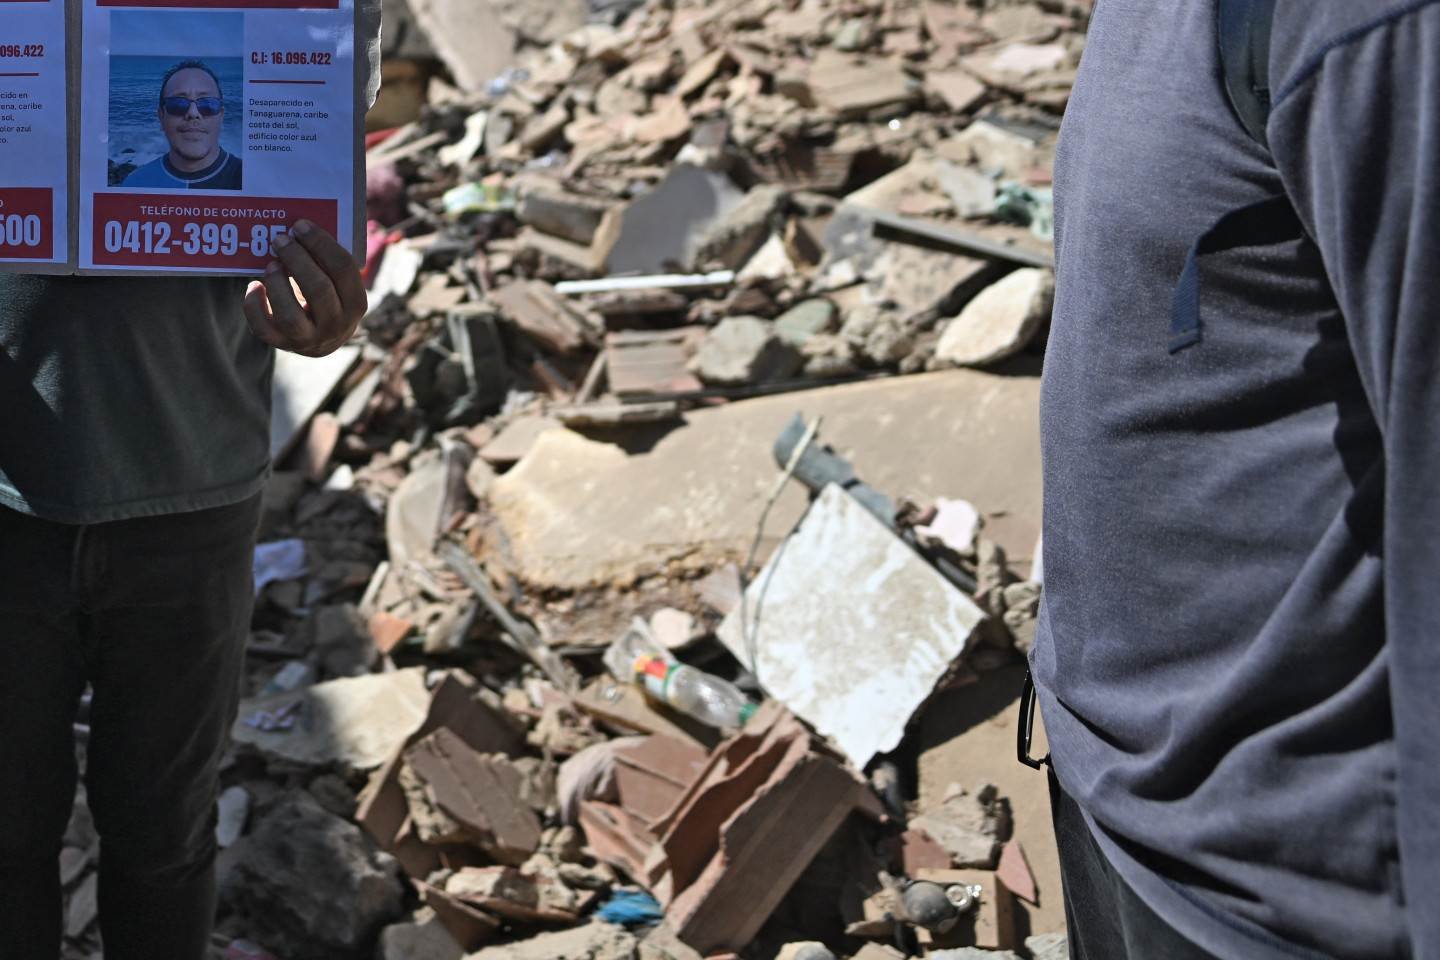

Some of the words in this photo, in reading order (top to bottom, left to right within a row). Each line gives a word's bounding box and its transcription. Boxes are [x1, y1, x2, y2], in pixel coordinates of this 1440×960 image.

[251, 52, 268, 65] C.I:
[271, 52, 331, 66] 16.096.422
[18, 102, 42, 110] caribe
[249, 98, 303, 108] Desaparecido
[304, 111, 329, 119] caribe
[249, 121, 271, 129] costa
[272, 121, 285, 129] del
[249, 132, 278, 141] edificio
[279, 133, 299, 141] color
[140, 205, 200, 217] TELÉFONO
[204, 208, 218, 217] DE
[222, 209, 286, 220] CONTACTO
